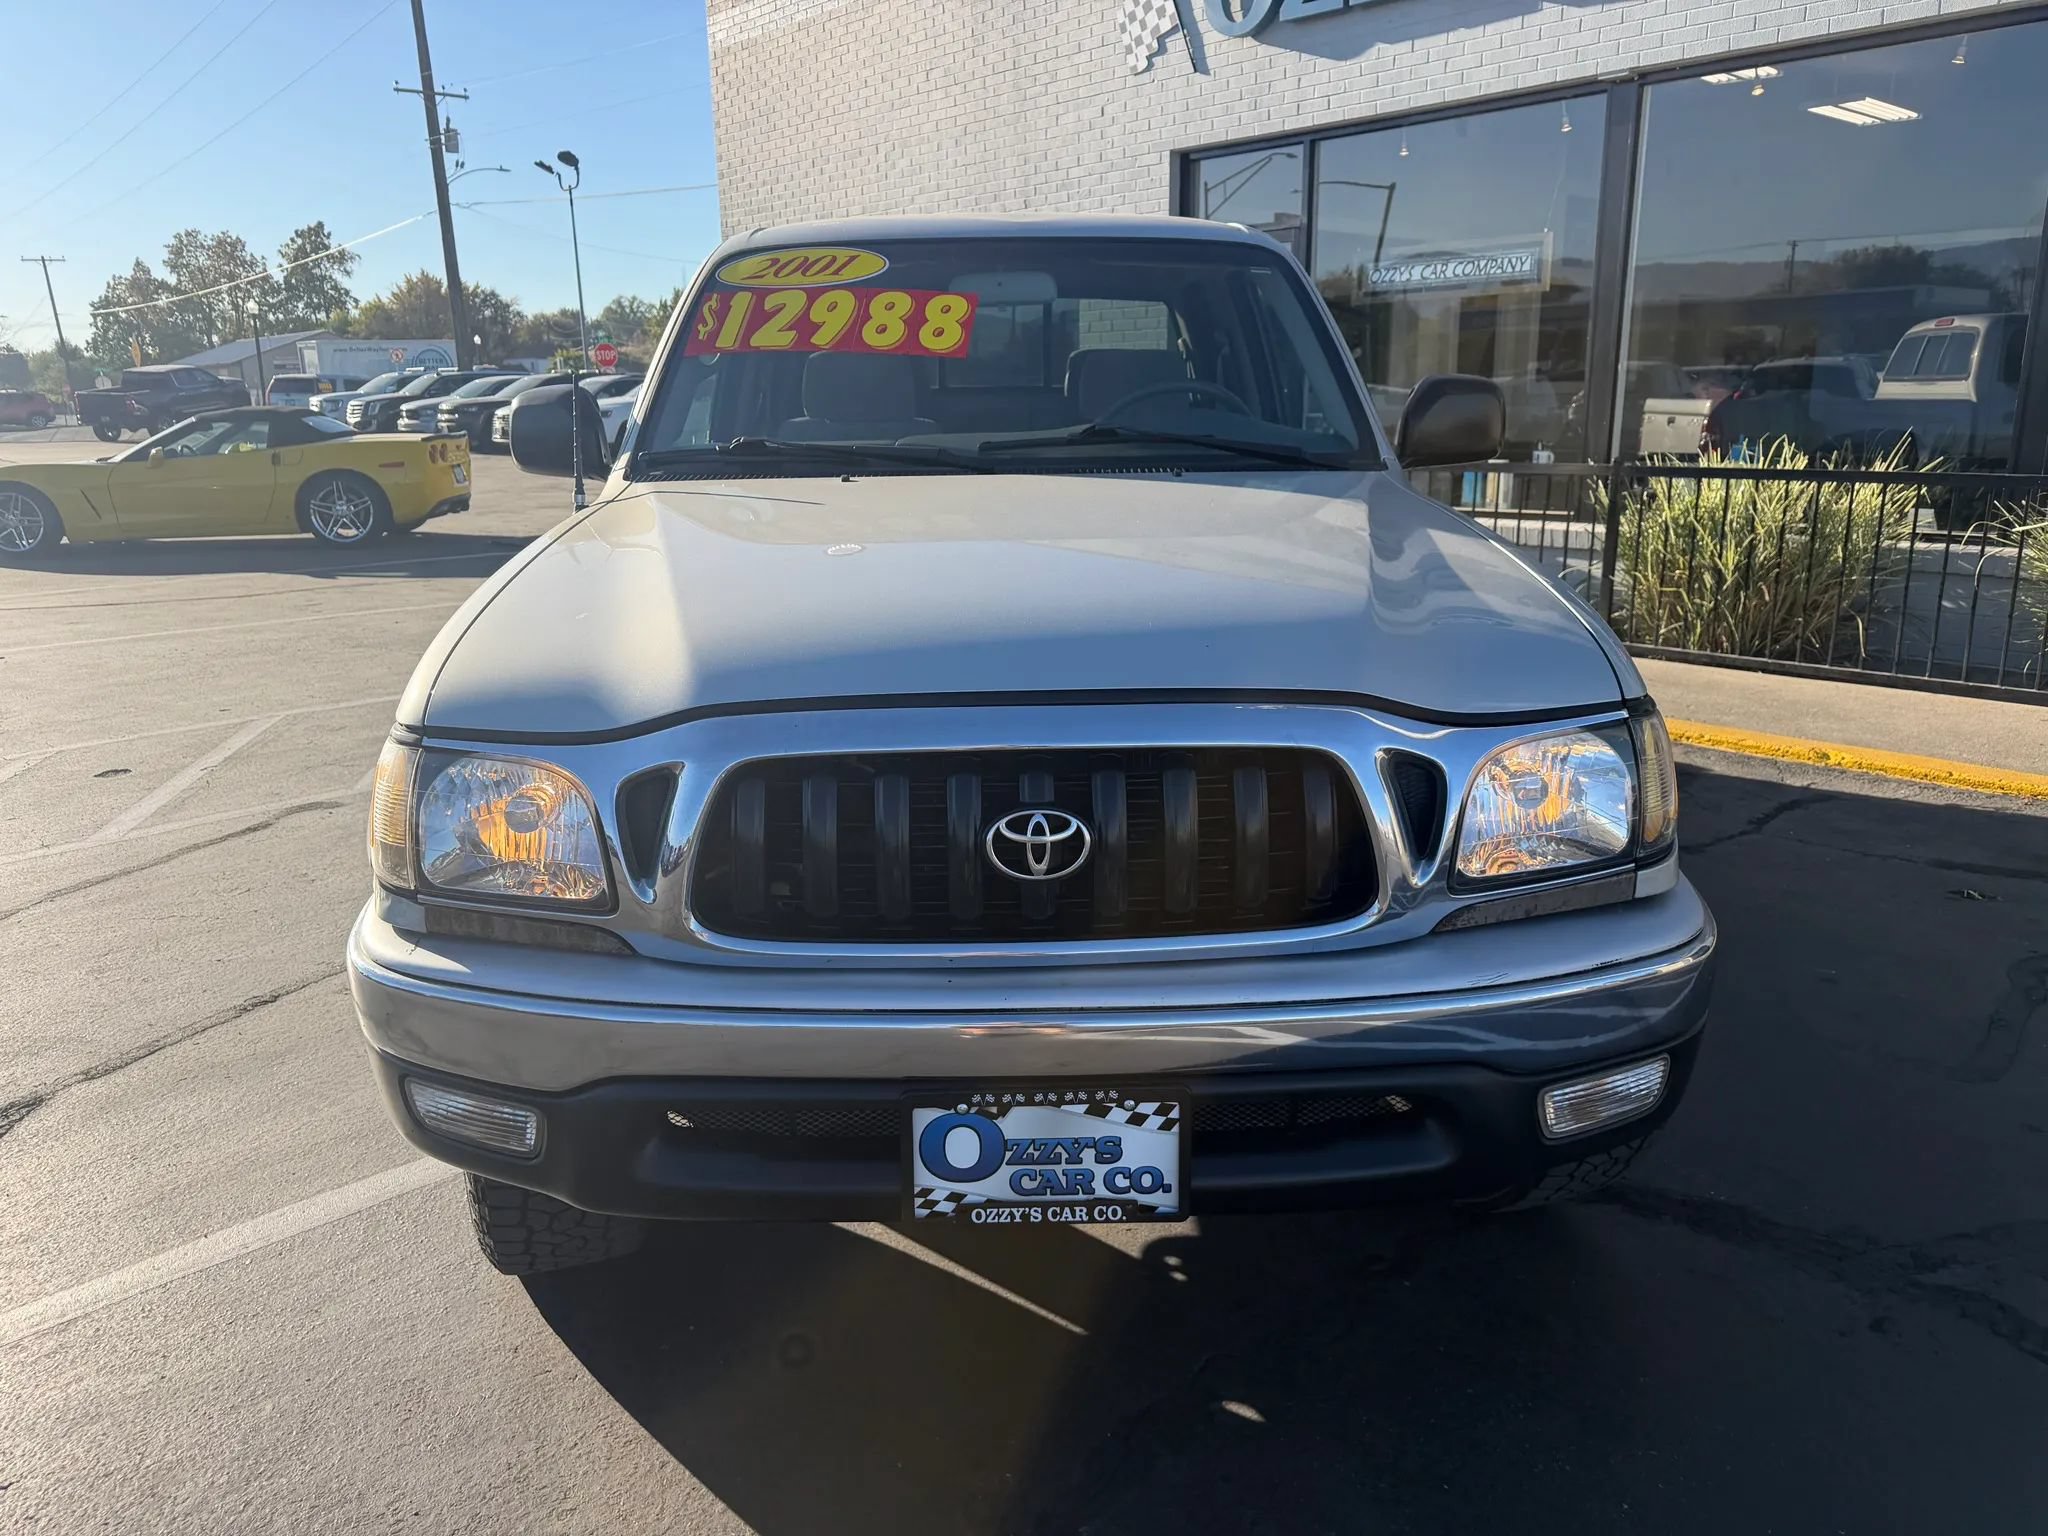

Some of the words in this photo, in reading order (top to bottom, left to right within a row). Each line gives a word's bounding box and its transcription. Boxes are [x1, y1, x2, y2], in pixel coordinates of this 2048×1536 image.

[743, 254, 860, 280] 2001
[1420, 263, 1448, 280] CAR
[1453, 256, 1530, 277] COMPANY
[697, 289, 971, 352] $12988
[596, 350, 616, 360] STOP
[1009, 1168, 1095, 1197] CAR
[1103, 1166, 1172, 1194] CO.
[971, 1207, 1042, 1224] OZZY'S
[1047, 1206, 1089, 1222] CAR
[1093, 1205, 1127, 1221] CO.
